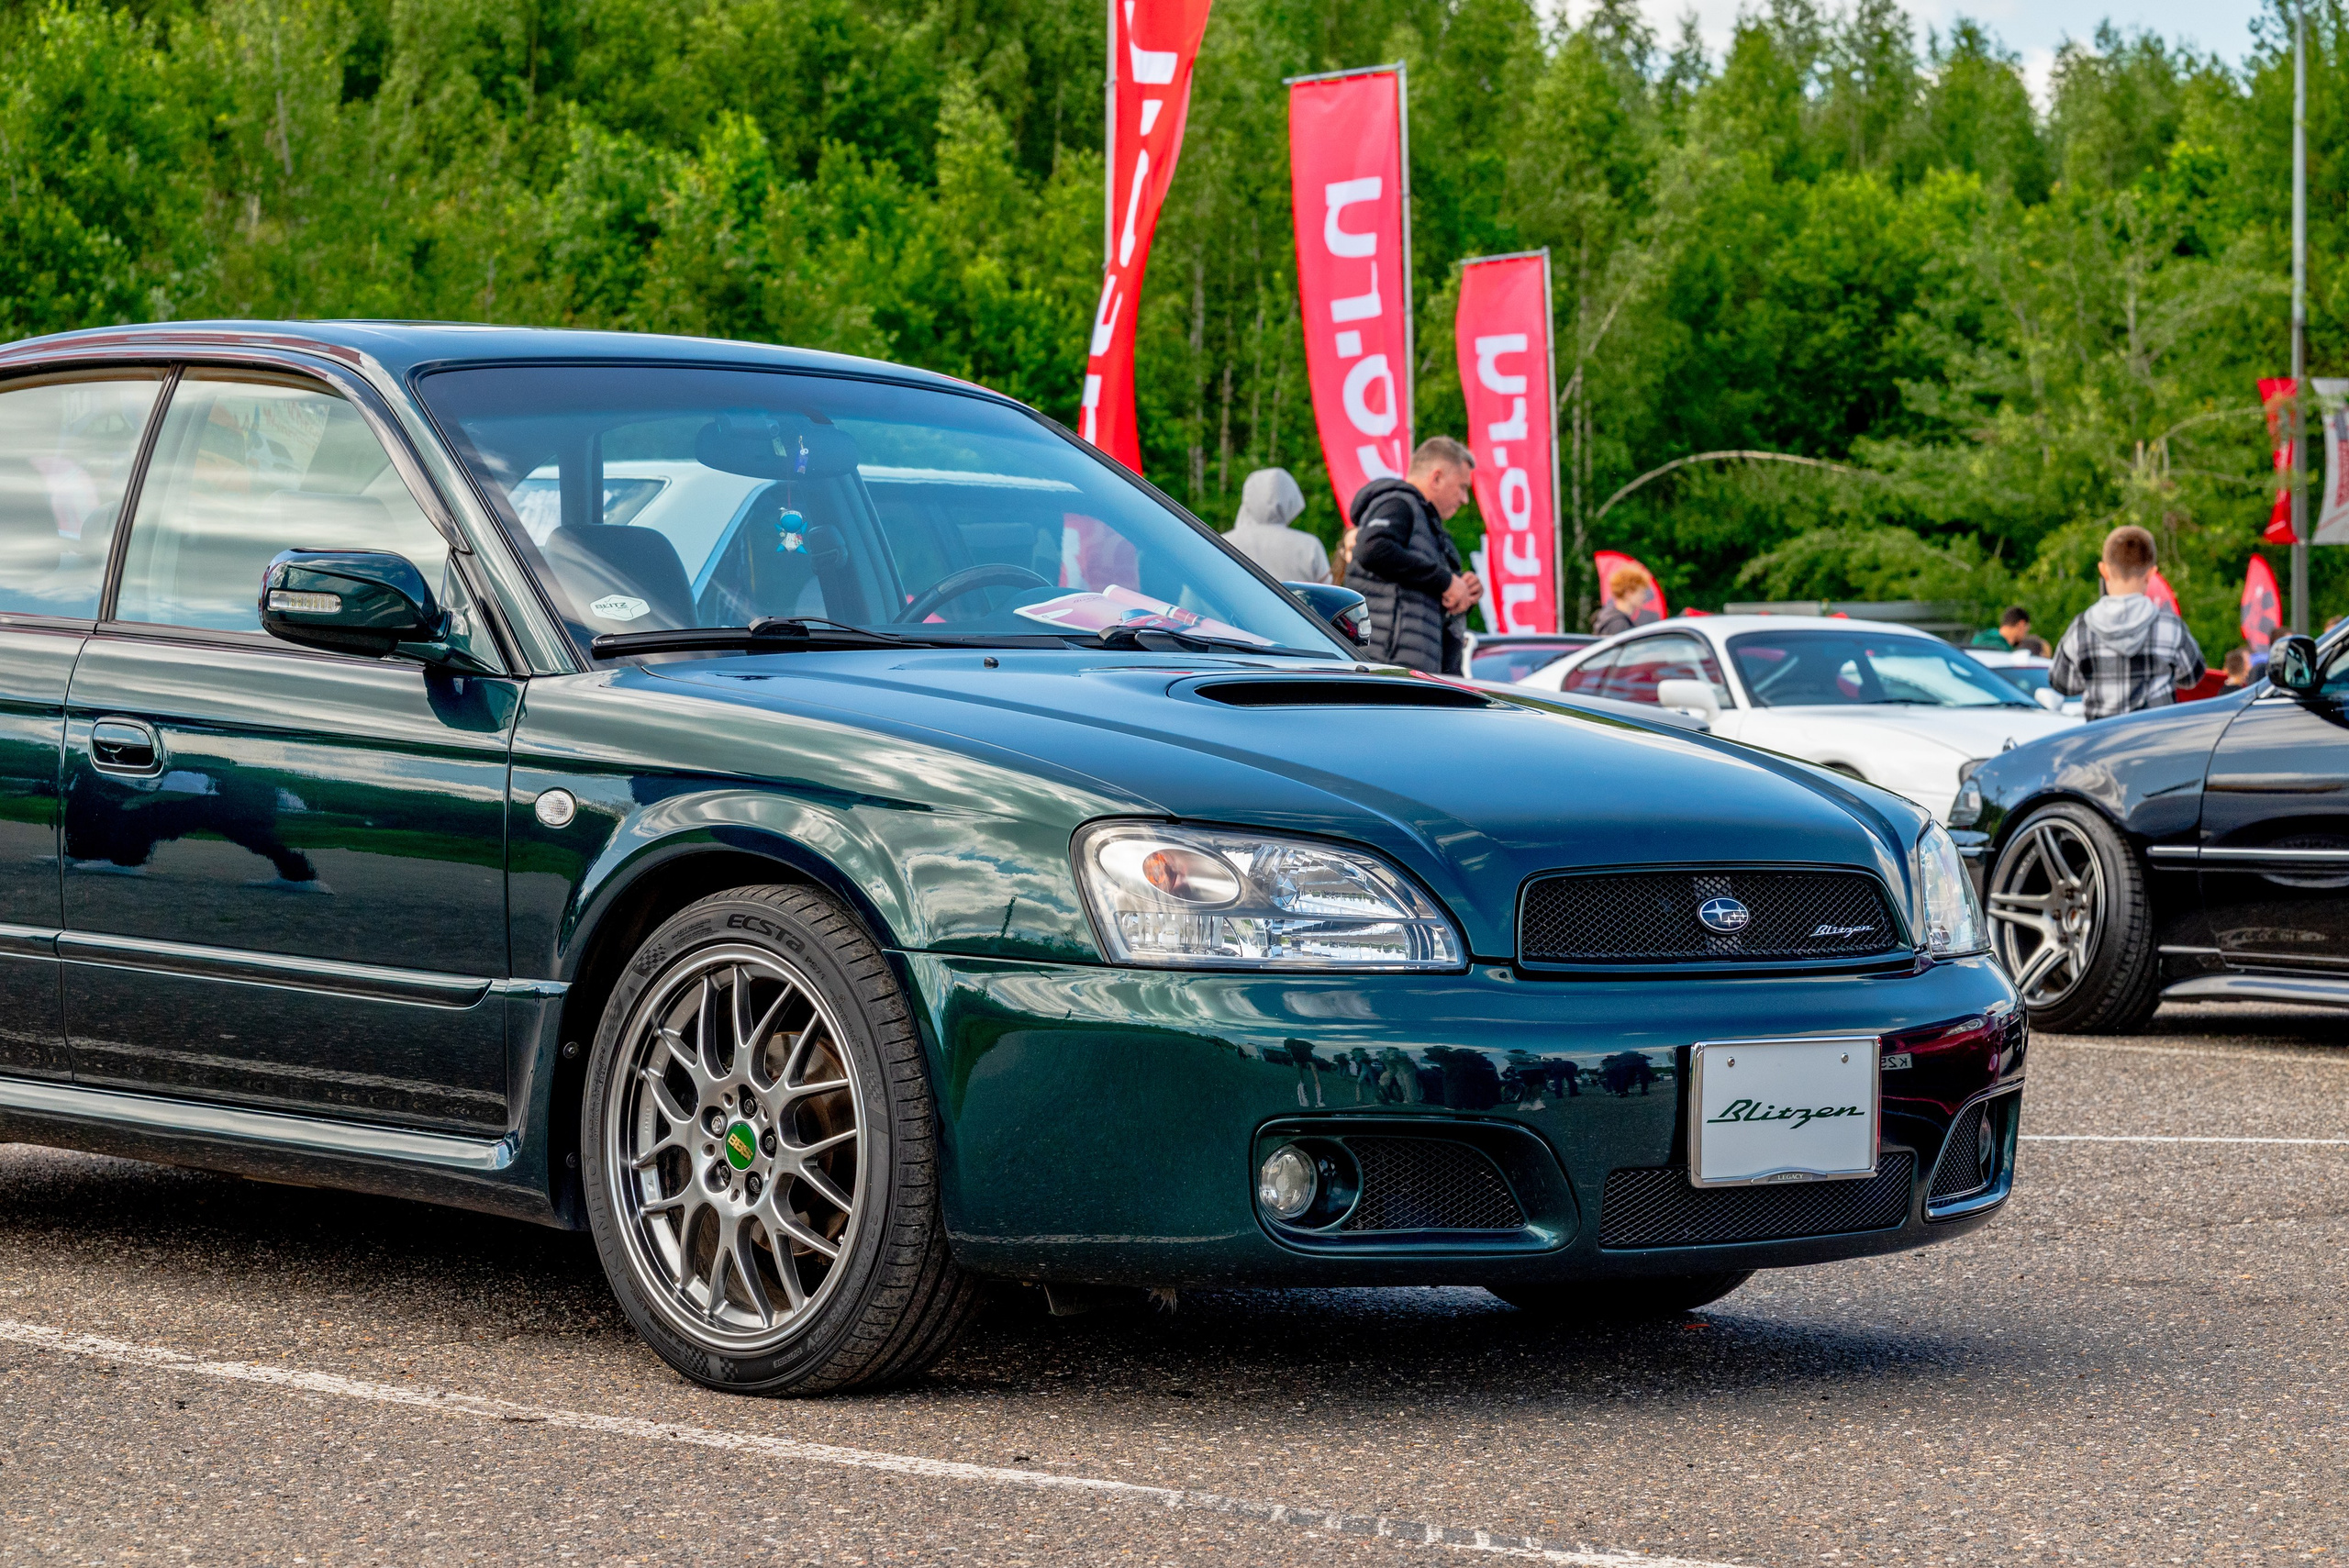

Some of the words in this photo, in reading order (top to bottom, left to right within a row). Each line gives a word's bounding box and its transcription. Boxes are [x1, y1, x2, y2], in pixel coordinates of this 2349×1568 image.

[1809, 924, 1875, 939] Blitzen
[1707, 1099, 1865, 1129] Blitzen
[728, 1133, 753, 1161] BBS
[586, 1156, 623, 1277] KUMHO
[774, 1350, 801, 1366] OUTSIDE
